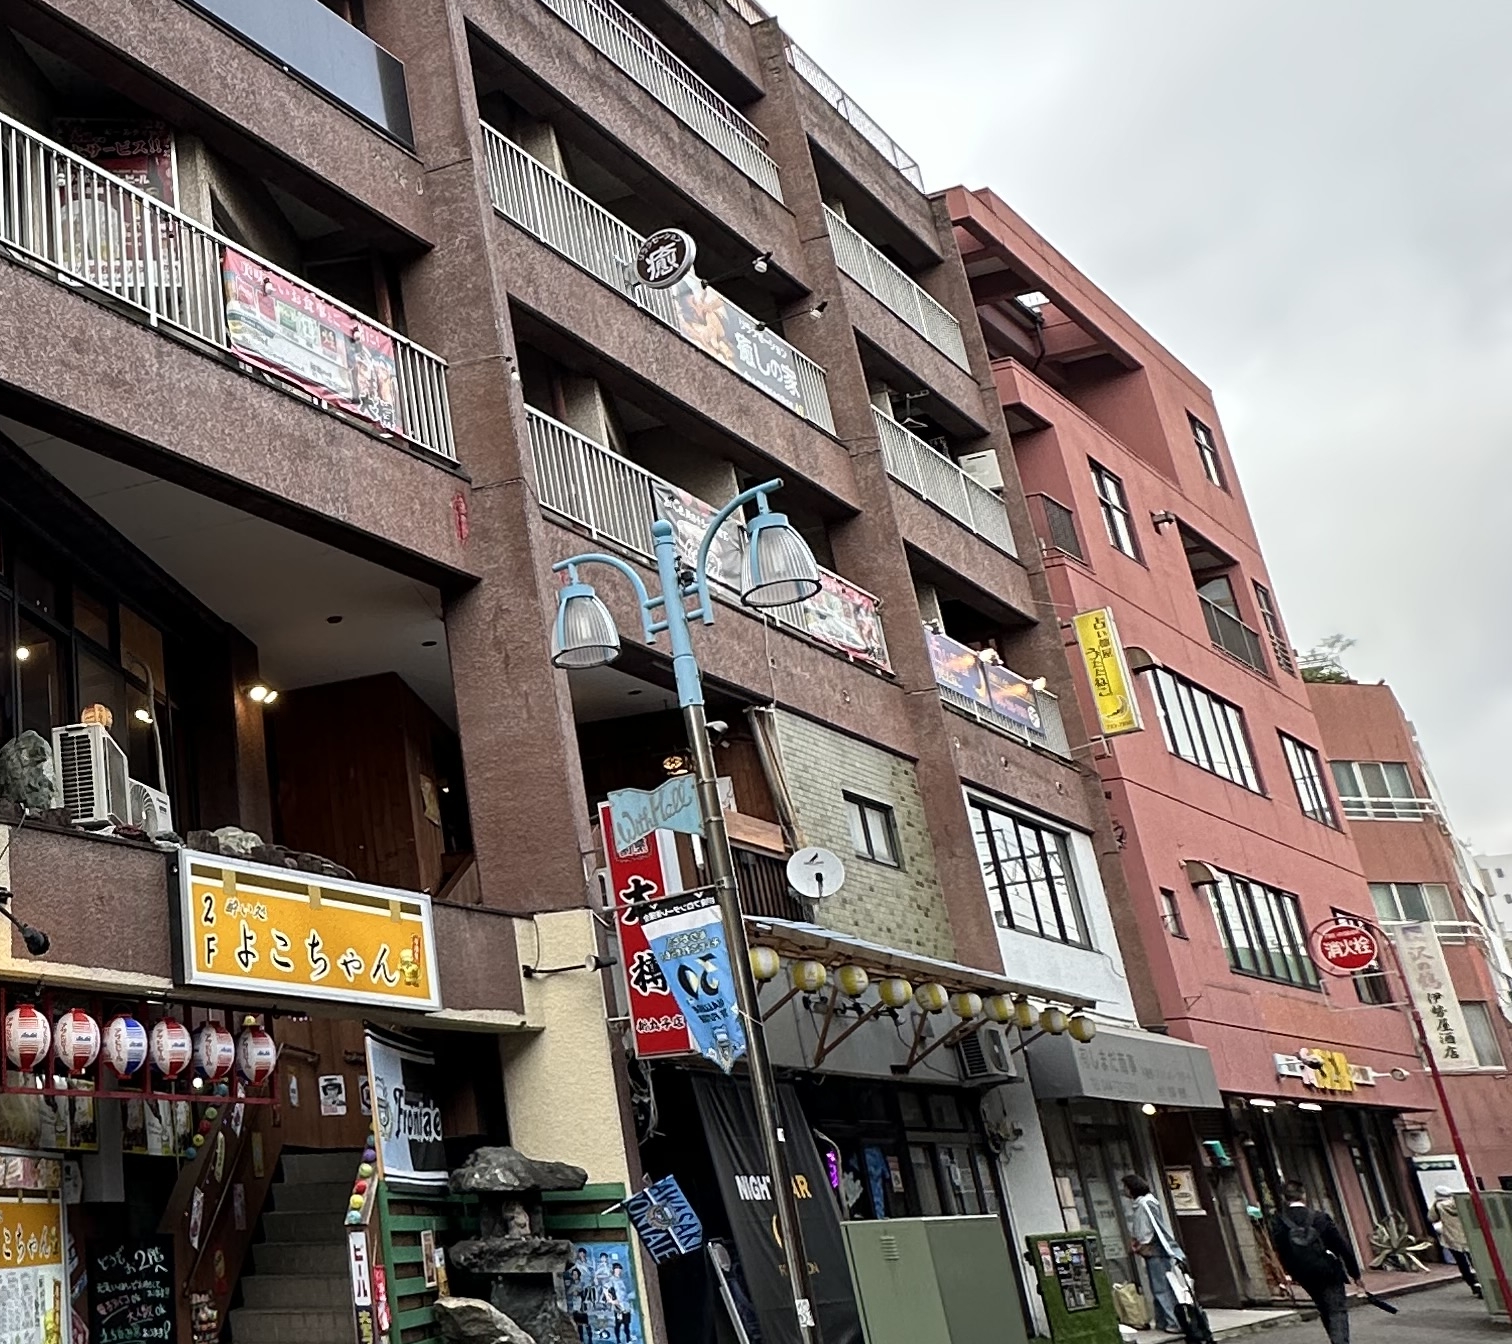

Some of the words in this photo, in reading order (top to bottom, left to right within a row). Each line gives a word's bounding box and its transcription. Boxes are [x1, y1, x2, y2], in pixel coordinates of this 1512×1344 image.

[645, 242, 679, 281] 癒
[201, 892, 219, 969] 2F
[236, 919, 400, 988] よこちゃん
[1322, 936, 1373, 959] 消火栓
[635, 1015, 686, 1034] 新丸子店
[1427, 992, 1460, 1059] 伊勢屋酒店
[735, 1175, 772, 1201] NIGH
[353, 1244, 368, 1298] ビール
